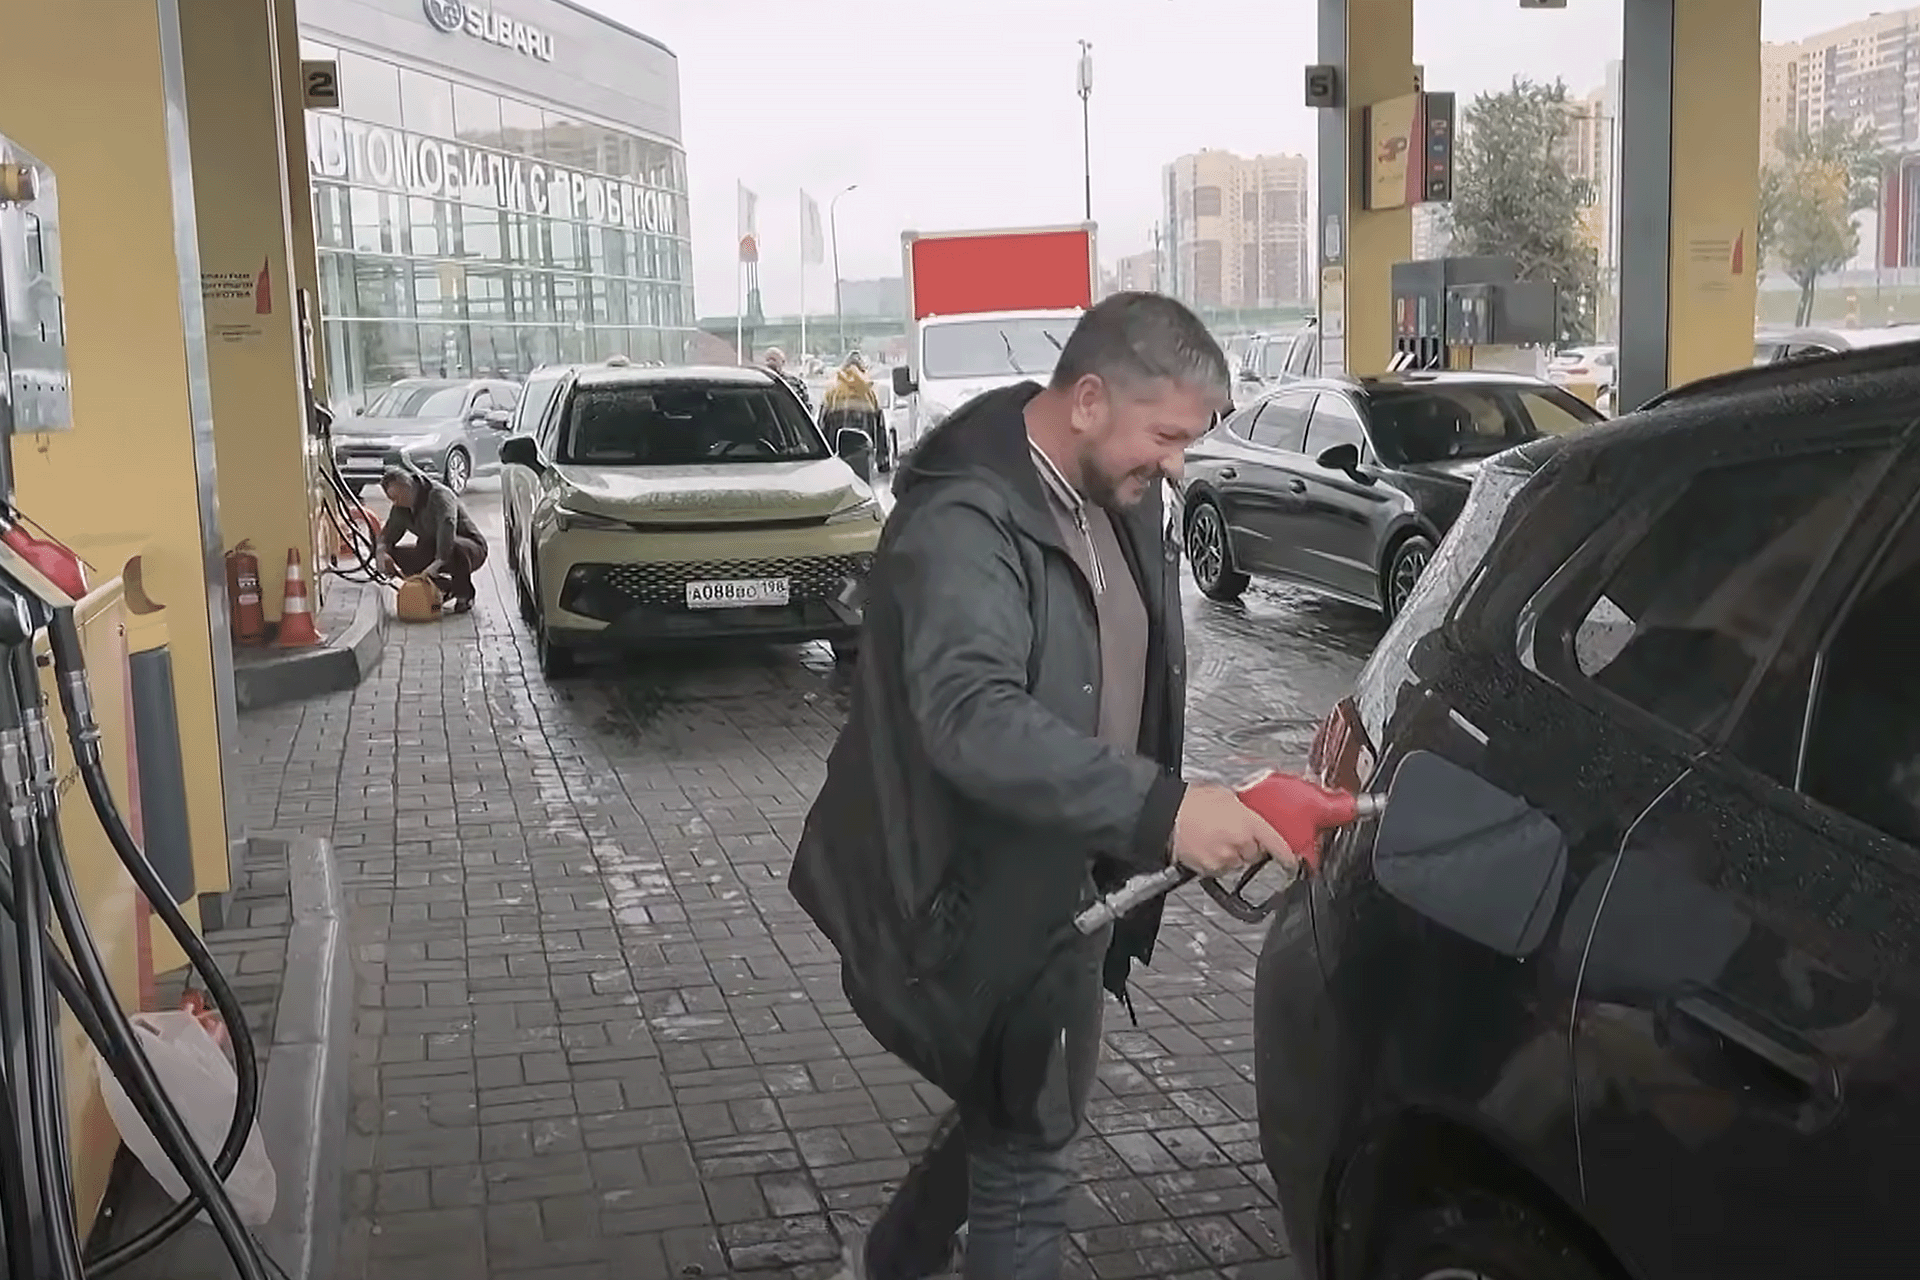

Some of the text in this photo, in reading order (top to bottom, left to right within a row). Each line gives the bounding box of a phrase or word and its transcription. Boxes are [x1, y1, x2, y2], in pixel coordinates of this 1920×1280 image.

[463, 4, 554, 61] SUBARU
[308, 70, 334, 97] 2
[1310, 75, 1329, 97] 5
